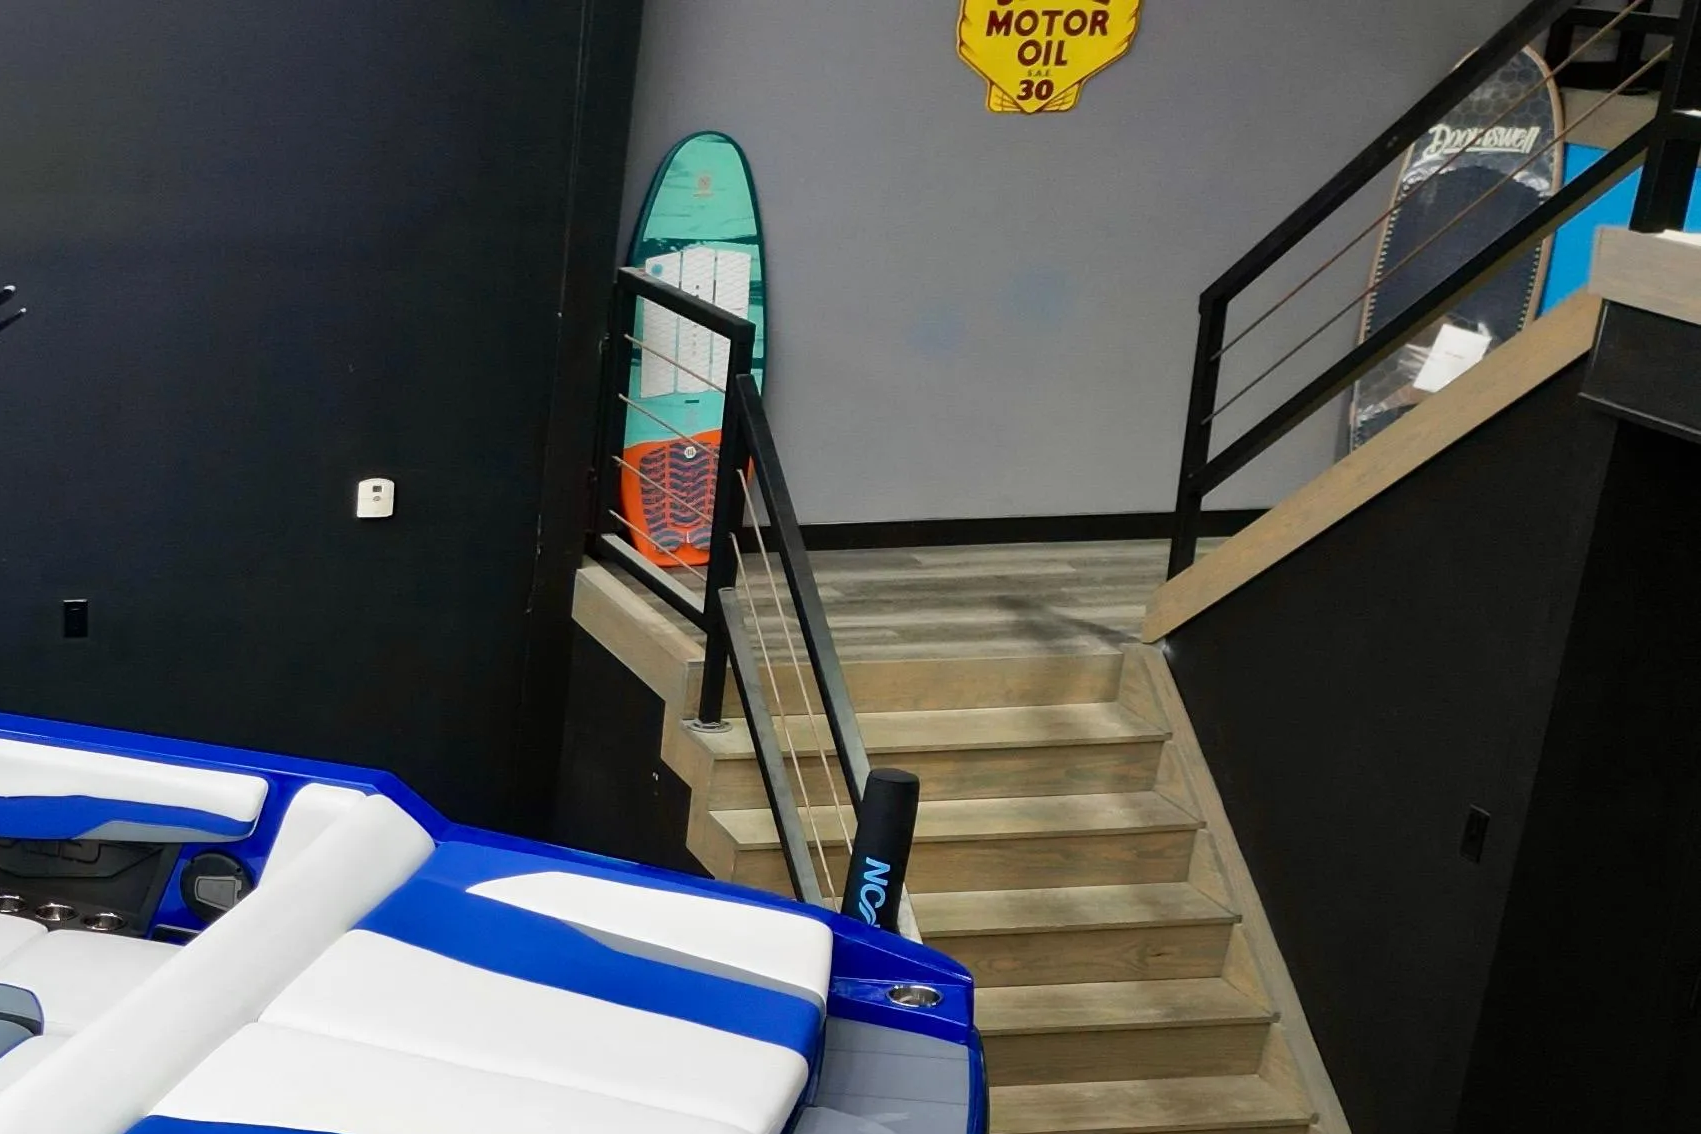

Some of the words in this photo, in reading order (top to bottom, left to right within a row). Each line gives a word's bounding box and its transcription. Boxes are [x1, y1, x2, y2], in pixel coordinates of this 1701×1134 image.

[986, 9, 1110, 37] MOTOR
[1017, 39, 1068, 67] OIL
[1016, 79, 1055, 101] 30
